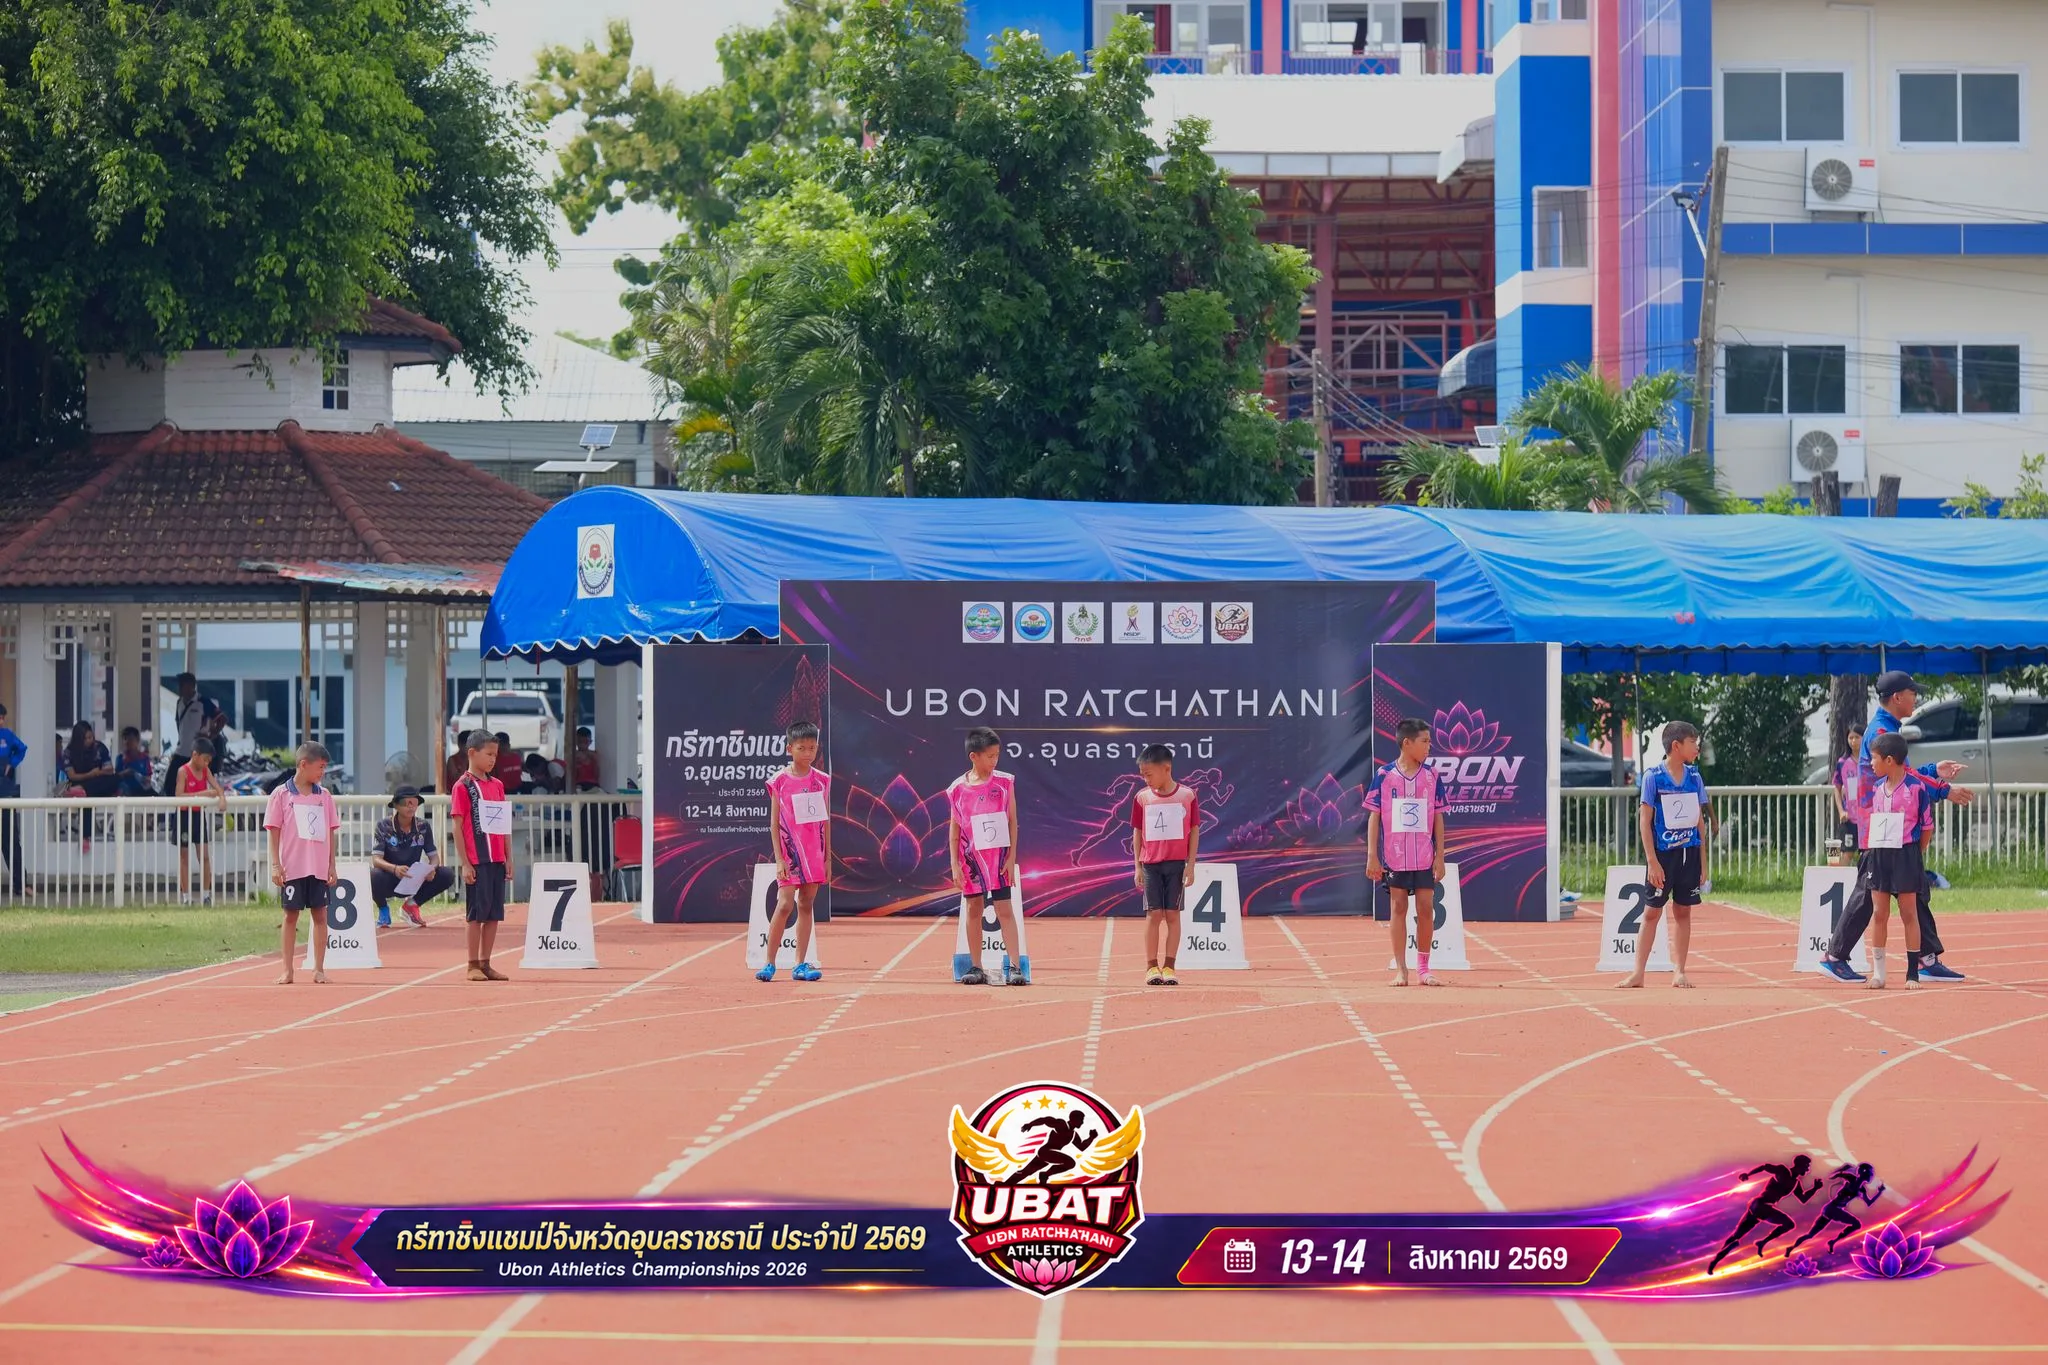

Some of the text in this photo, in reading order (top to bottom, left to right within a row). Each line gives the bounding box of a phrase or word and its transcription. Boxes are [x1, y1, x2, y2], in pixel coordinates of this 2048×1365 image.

[1217, 622, 1246, 631] UBAT
[885, 688, 1338, 717] UBON RATCHATHANI
[1006, 735, 1214, 767] จ.อุบลราานี
[1425, 756, 1525, 784] BON
[718, 788, 766, 797] ประจำปี 2569
[1444, 785, 1519, 800] LETICS
[485, 805, 503, 826] 7
[725, 804, 768, 817] สิงหาคม
[807, 798, 816, 816] 6
[1402, 802, 1420, 827] 3
[1672, 799, 1688, 819] 2
[306, 811, 318, 836] 8
[982, 820, 997, 843] 5
[1154, 811, 1168, 833] 4
[1875, 818, 1894, 841] 1
[285, 885, 295, 900] 9
[327, 878, 358, 931] 8
[543, 879, 577, 932] 7
[1192, 880, 1226, 933] 4
[1618, 883, 1648, 934] 2
[1820, 882, 1844, 934] 1
[537, 935, 578, 951] Nelco
[981, 936, 1007, 951] elco
[1187, 935, 1227, 952] Nelco
[1612, 938, 1636, 954] Nel
